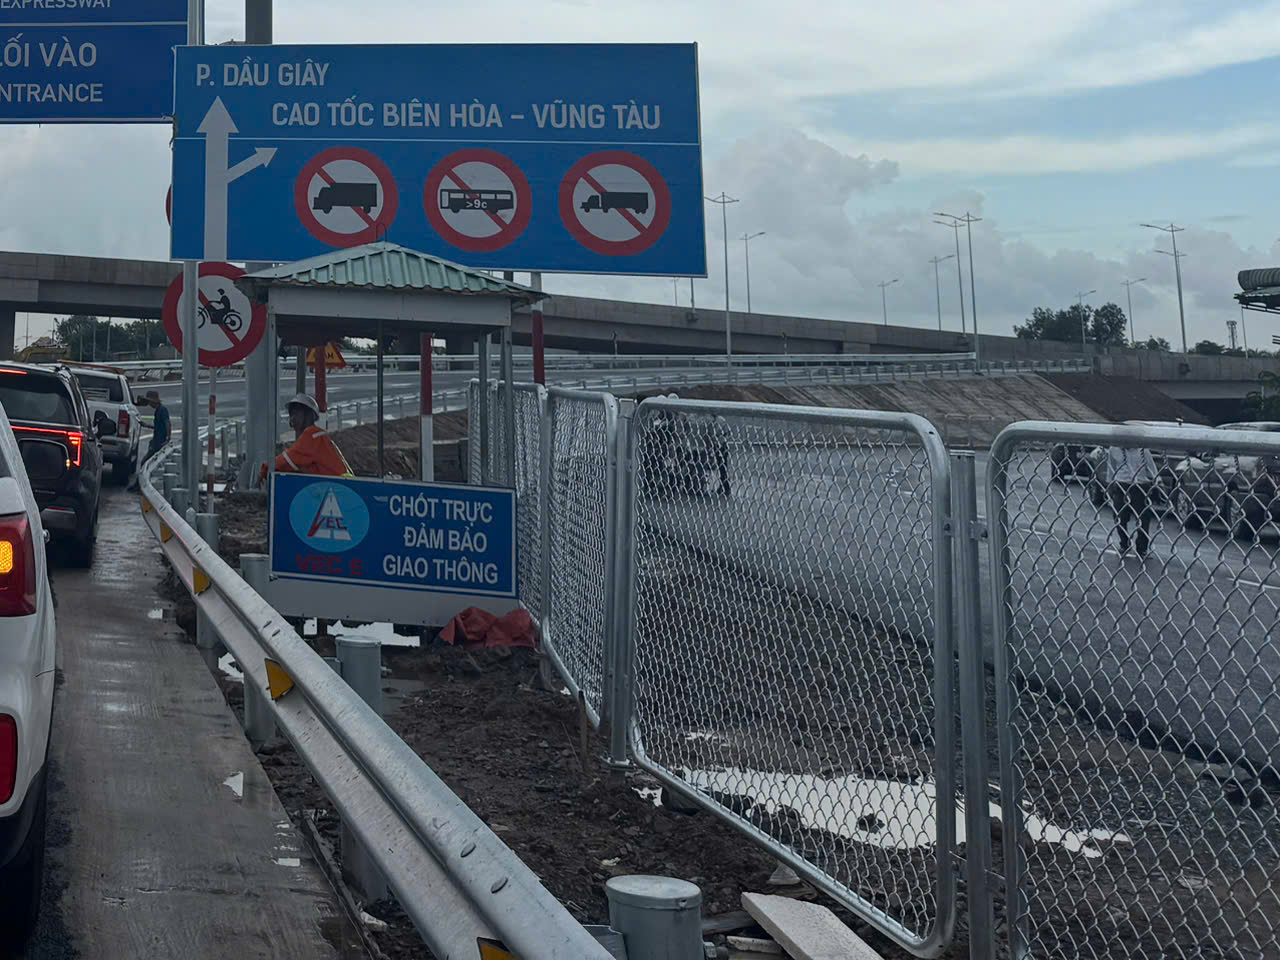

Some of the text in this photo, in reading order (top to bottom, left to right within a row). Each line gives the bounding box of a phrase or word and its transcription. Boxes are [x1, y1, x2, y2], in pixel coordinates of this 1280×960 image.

[39, 36, 97, 68] VÀO
[196, 56, 330, 87] P. DẦU GIÂY
[272, 102, 320, 126] CAO
[327, 95, 374, 127] TỐC
[382, 98, 440, 128] BIÊN
[450, 98, 504, 128] HÒA
[531, 99, 605, 129] VŨNG
[612, 100, 661, 130] TÀU
[442, 498, 493, 527] TRỰC
[403, 522, 488, 553] ĐẢM BẢO
[295, 552, 343, 575] VEC
[382, 554, 498, 584] GIAO THÔNG
